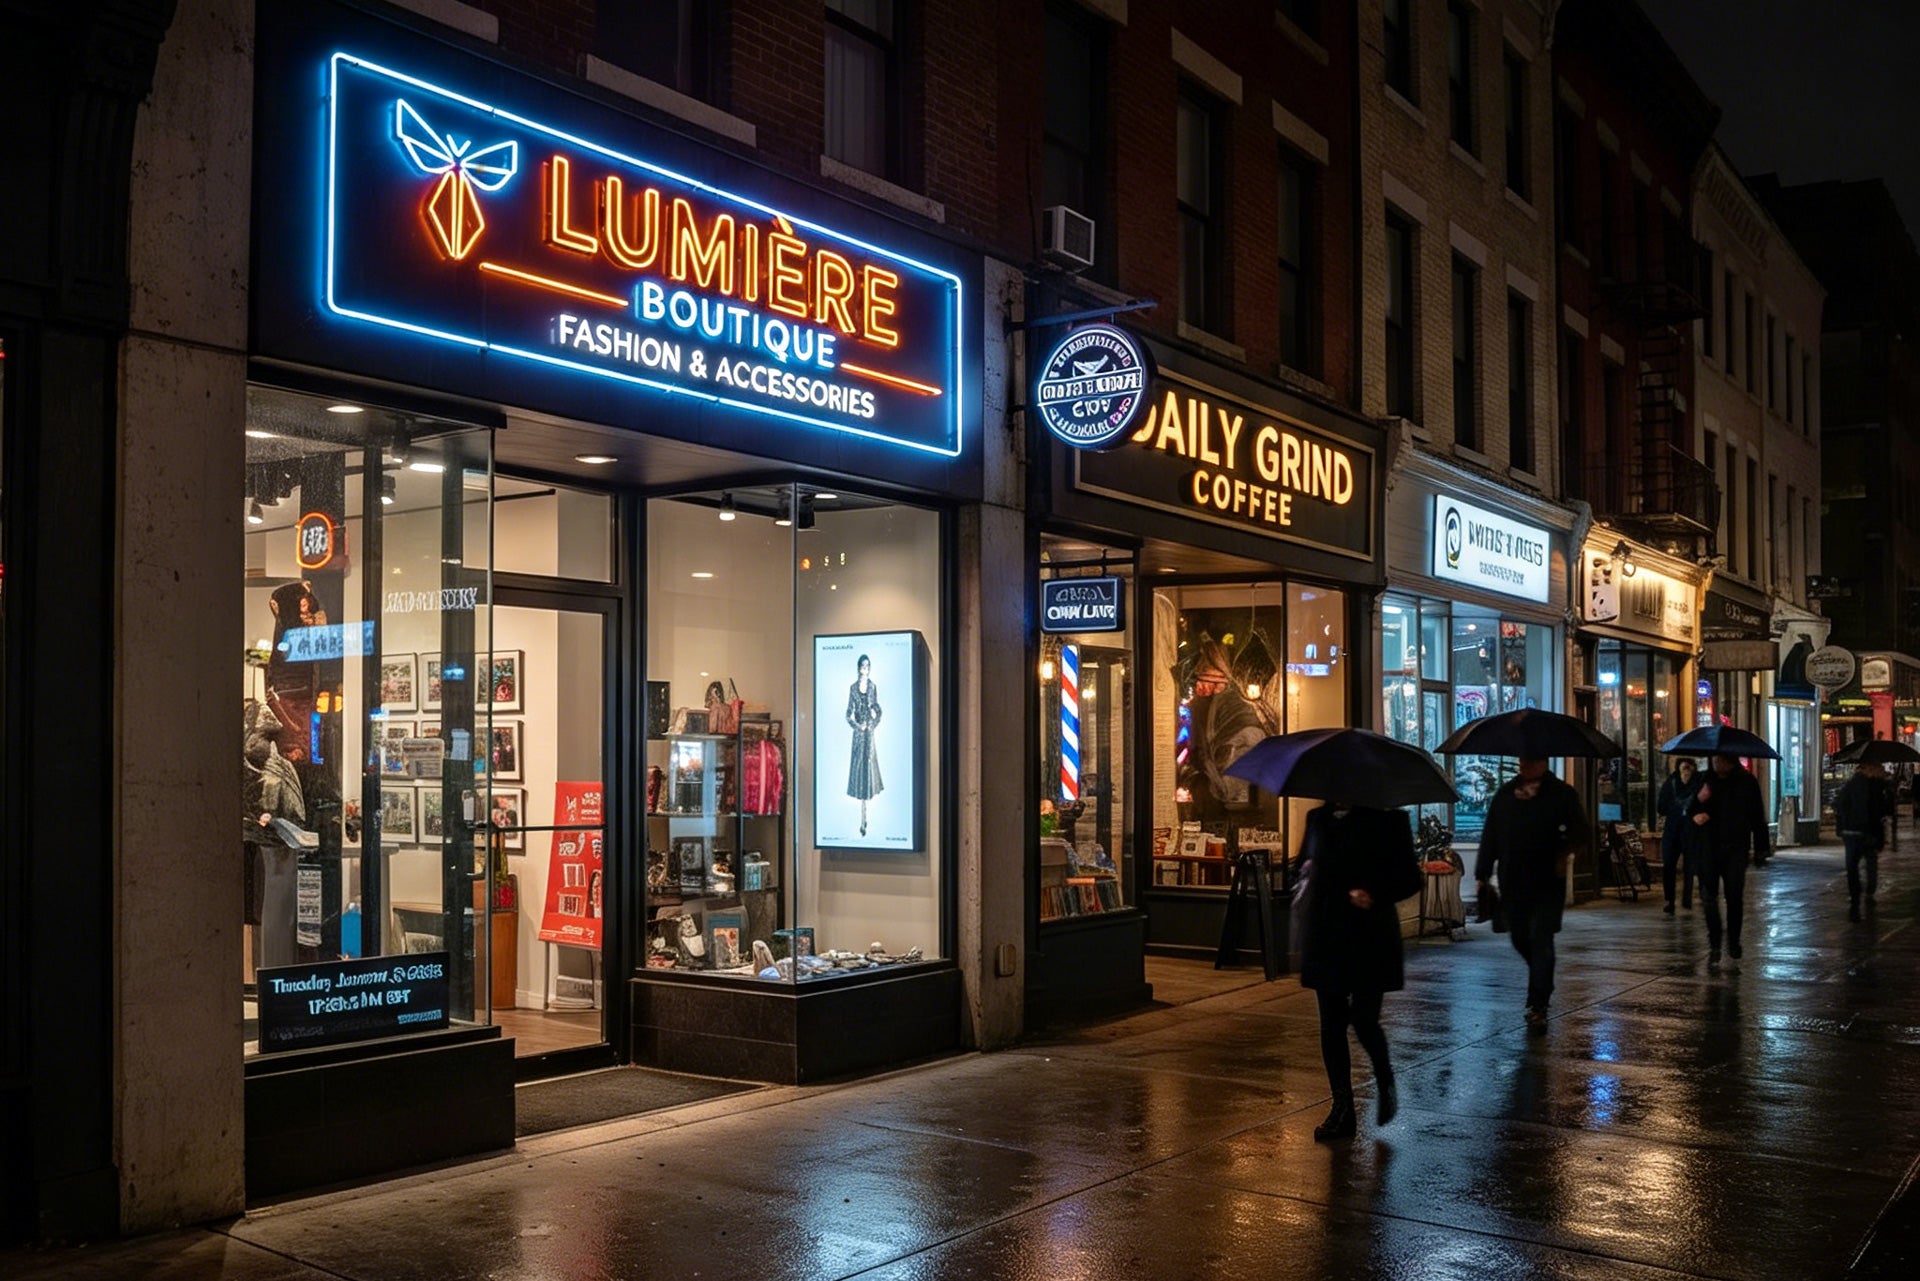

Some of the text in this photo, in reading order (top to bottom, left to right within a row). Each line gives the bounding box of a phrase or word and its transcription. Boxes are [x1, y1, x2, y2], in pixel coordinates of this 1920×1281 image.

[551, 155, 899, 347] LUMIÈRE
[559, 313, 876, 419] FASHION & ACCESSORIES
[640, 281, 837, 369] BOUTIQUE
[1192, 469, 1293, 526] COFFEE
[1255, 425, 1354, 505] GRIND
